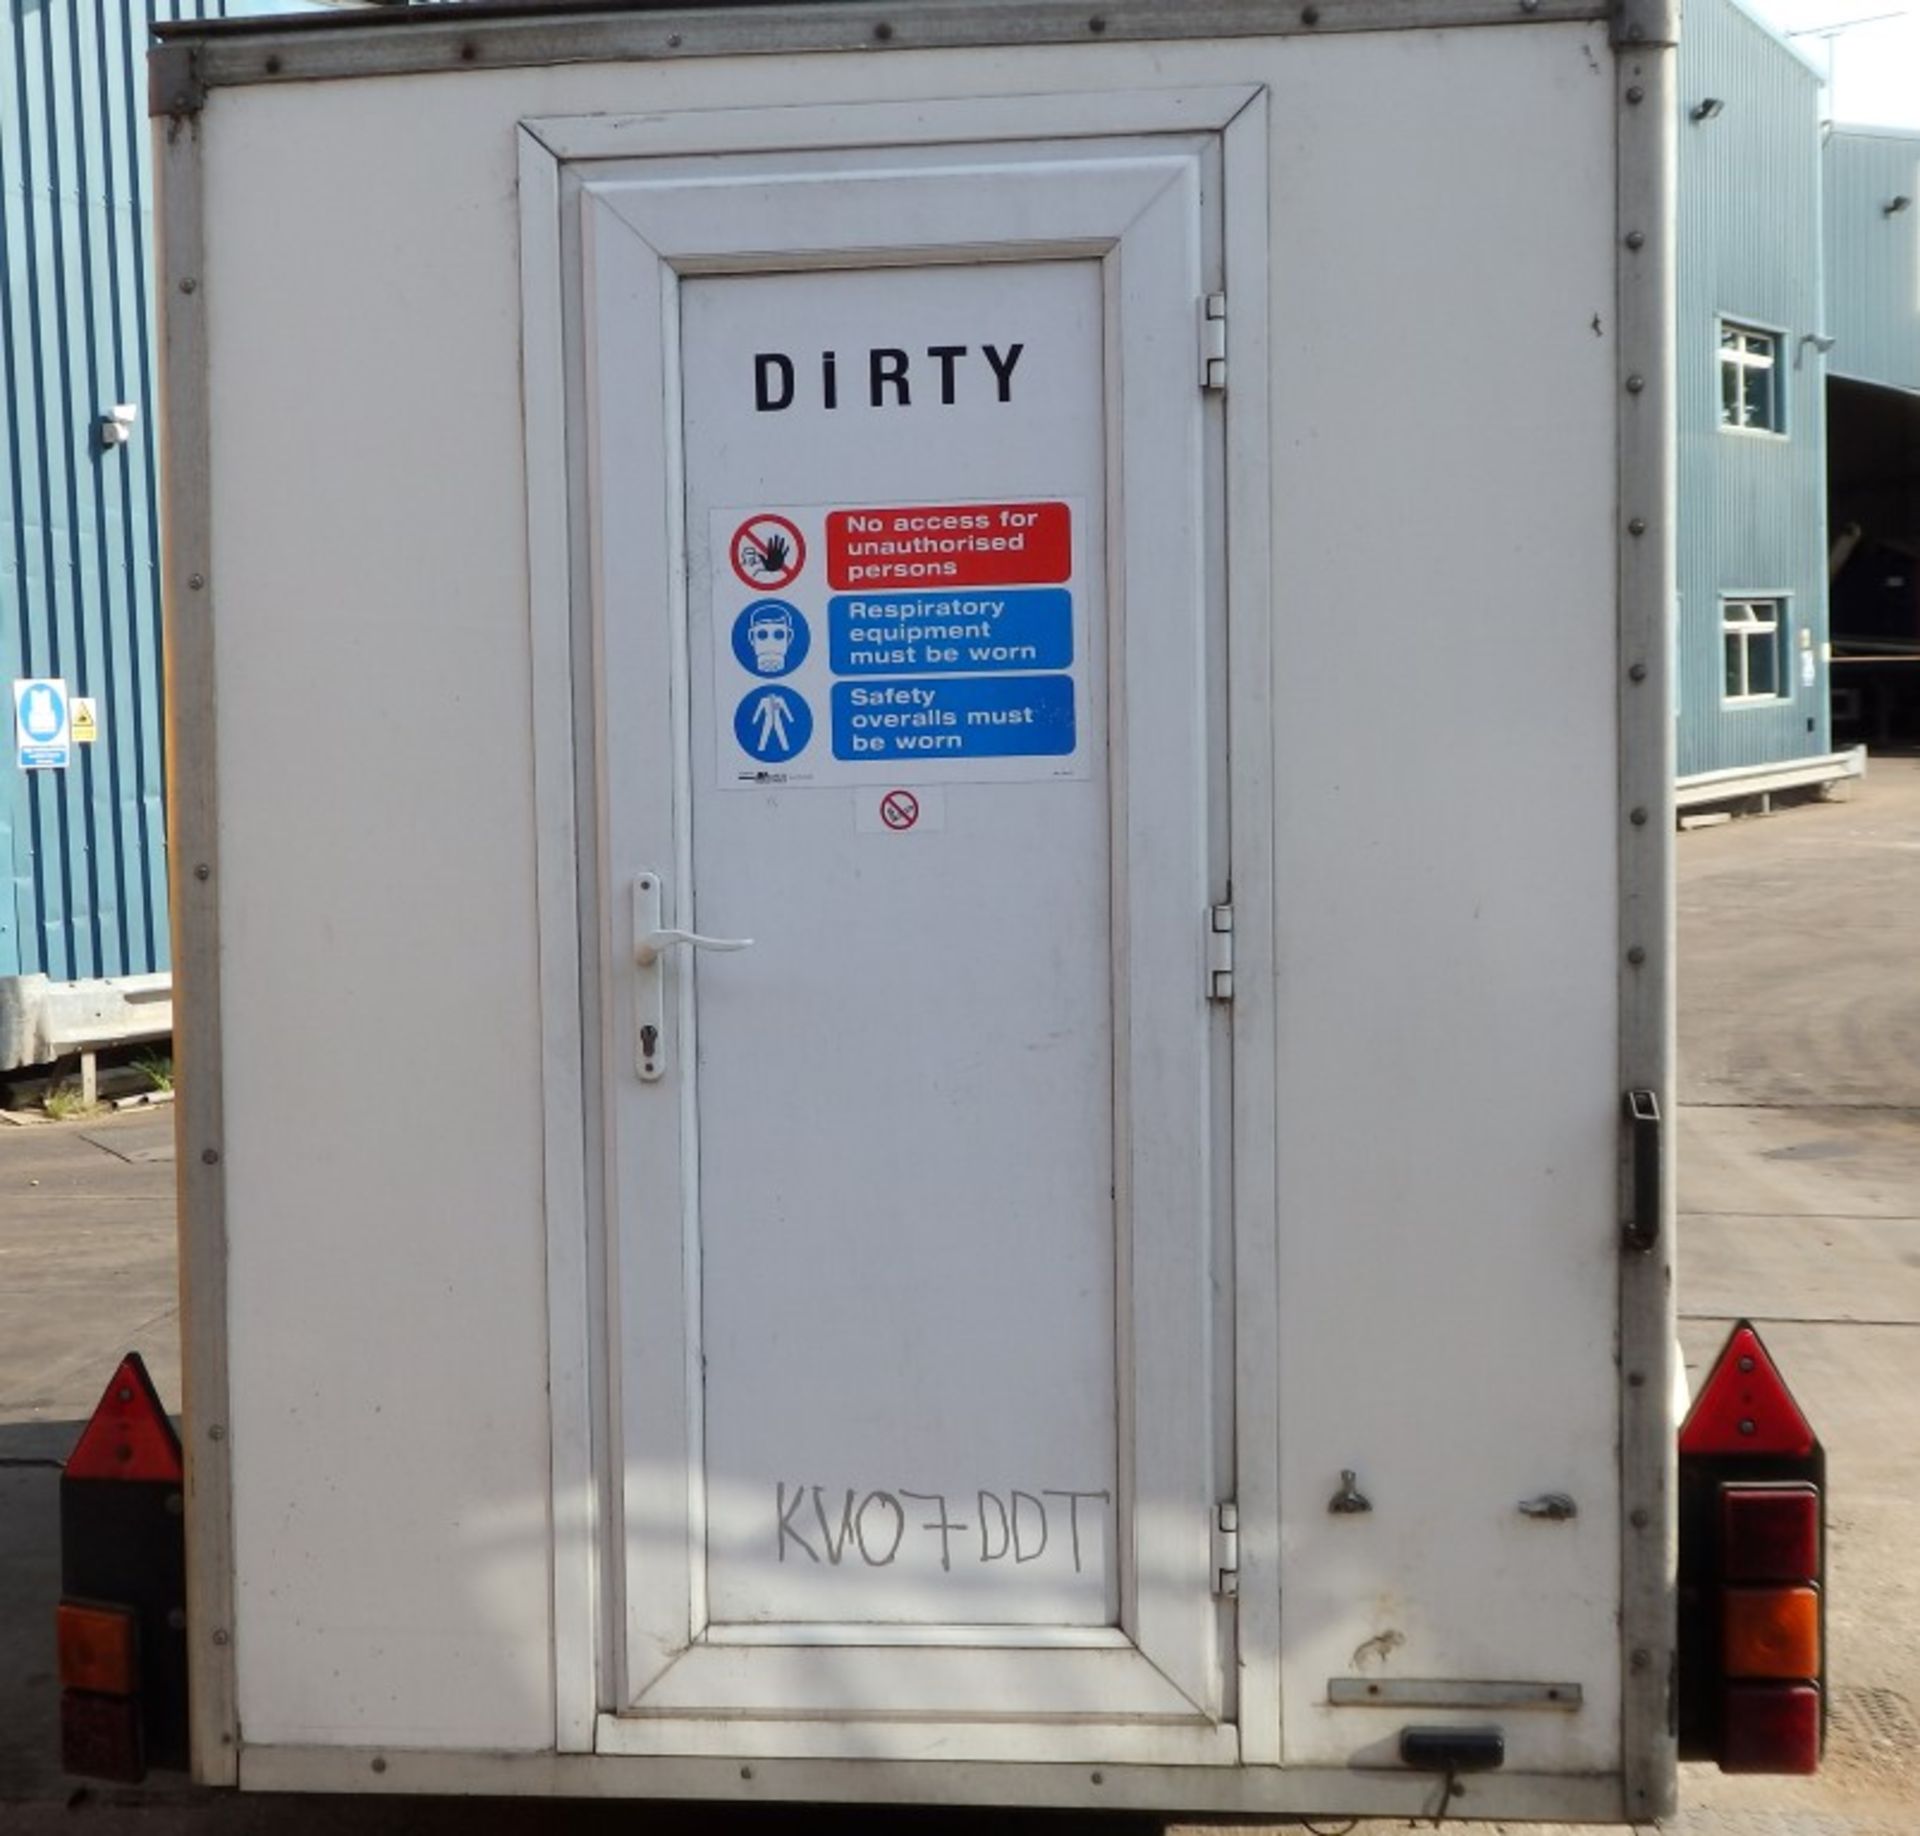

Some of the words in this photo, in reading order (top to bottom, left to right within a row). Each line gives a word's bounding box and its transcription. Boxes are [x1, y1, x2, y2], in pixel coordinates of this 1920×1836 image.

[847, 516, 883, 533] No
[894, 514, 990, 531] access
[1000, 511, 1038, 527] for
[847, 533, 1025, 556] unauthorised
[848, 561, 957, 582] persons
[849, 599, 1005, 621] Respiratory
[849, 621, 991, 645] equipment
[850, 647, 916, 664] must
[926, 646, 959, 662] be
[968, 645, 1036, 661] worn
[851, 688, 936, 708] Safety
[852, 709, 957, 728] overalls
[967, 707, 1034, 725] must
[852, 735, 885, 751] be
[895, 734, 962, 750] worn
